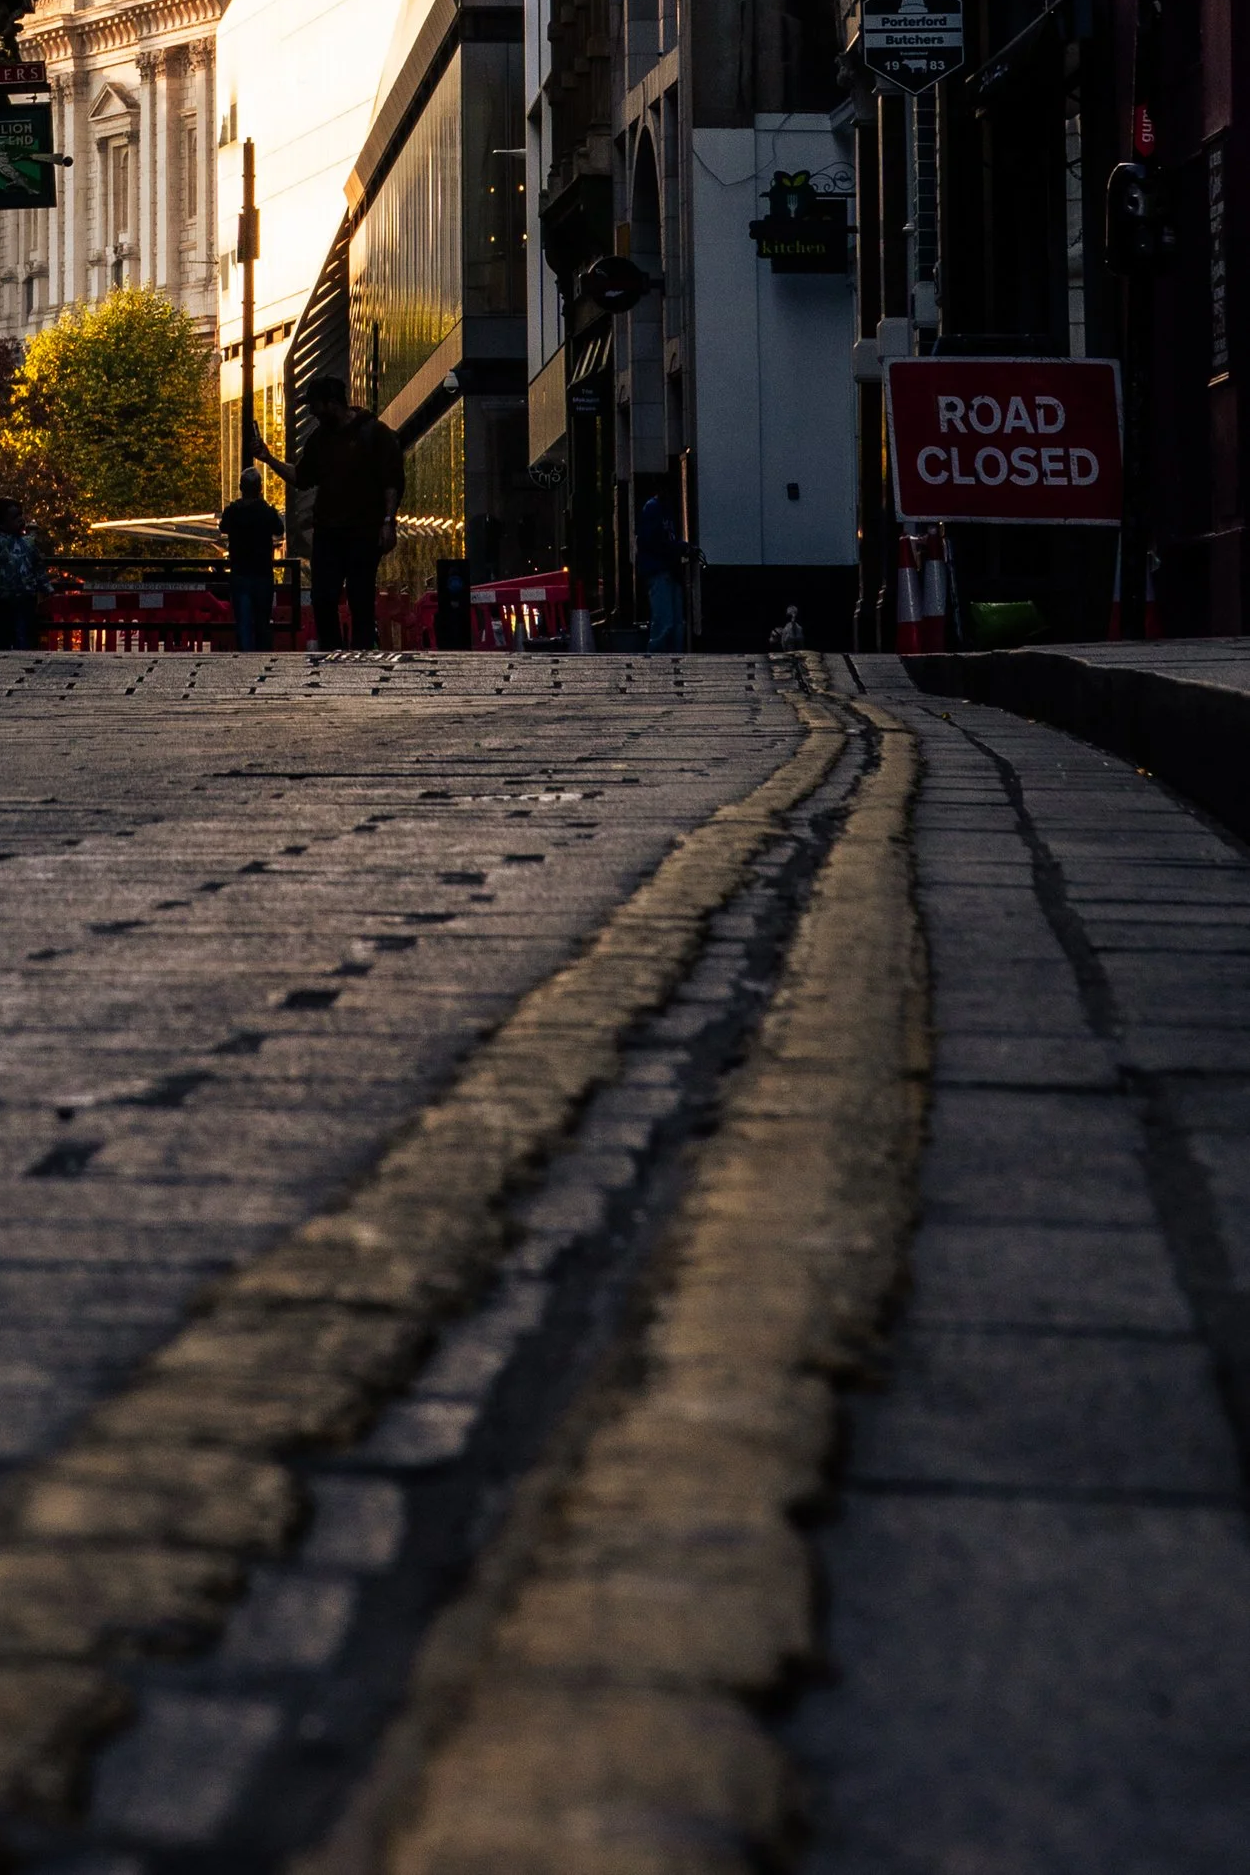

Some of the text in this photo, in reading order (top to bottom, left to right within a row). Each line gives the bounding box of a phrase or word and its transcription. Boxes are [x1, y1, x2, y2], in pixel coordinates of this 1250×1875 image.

[881, 16, 947, 27] Porterford
[885, 35, 944, 45] Butchers
[884, 60, 946, 71] 19 83
[8, 135, 34, 146] END
[761, 239, 827, 254] kitchen
[937, 394, 1066, 435] ROAD
[916, 445, 1100, 486] CLOSED
